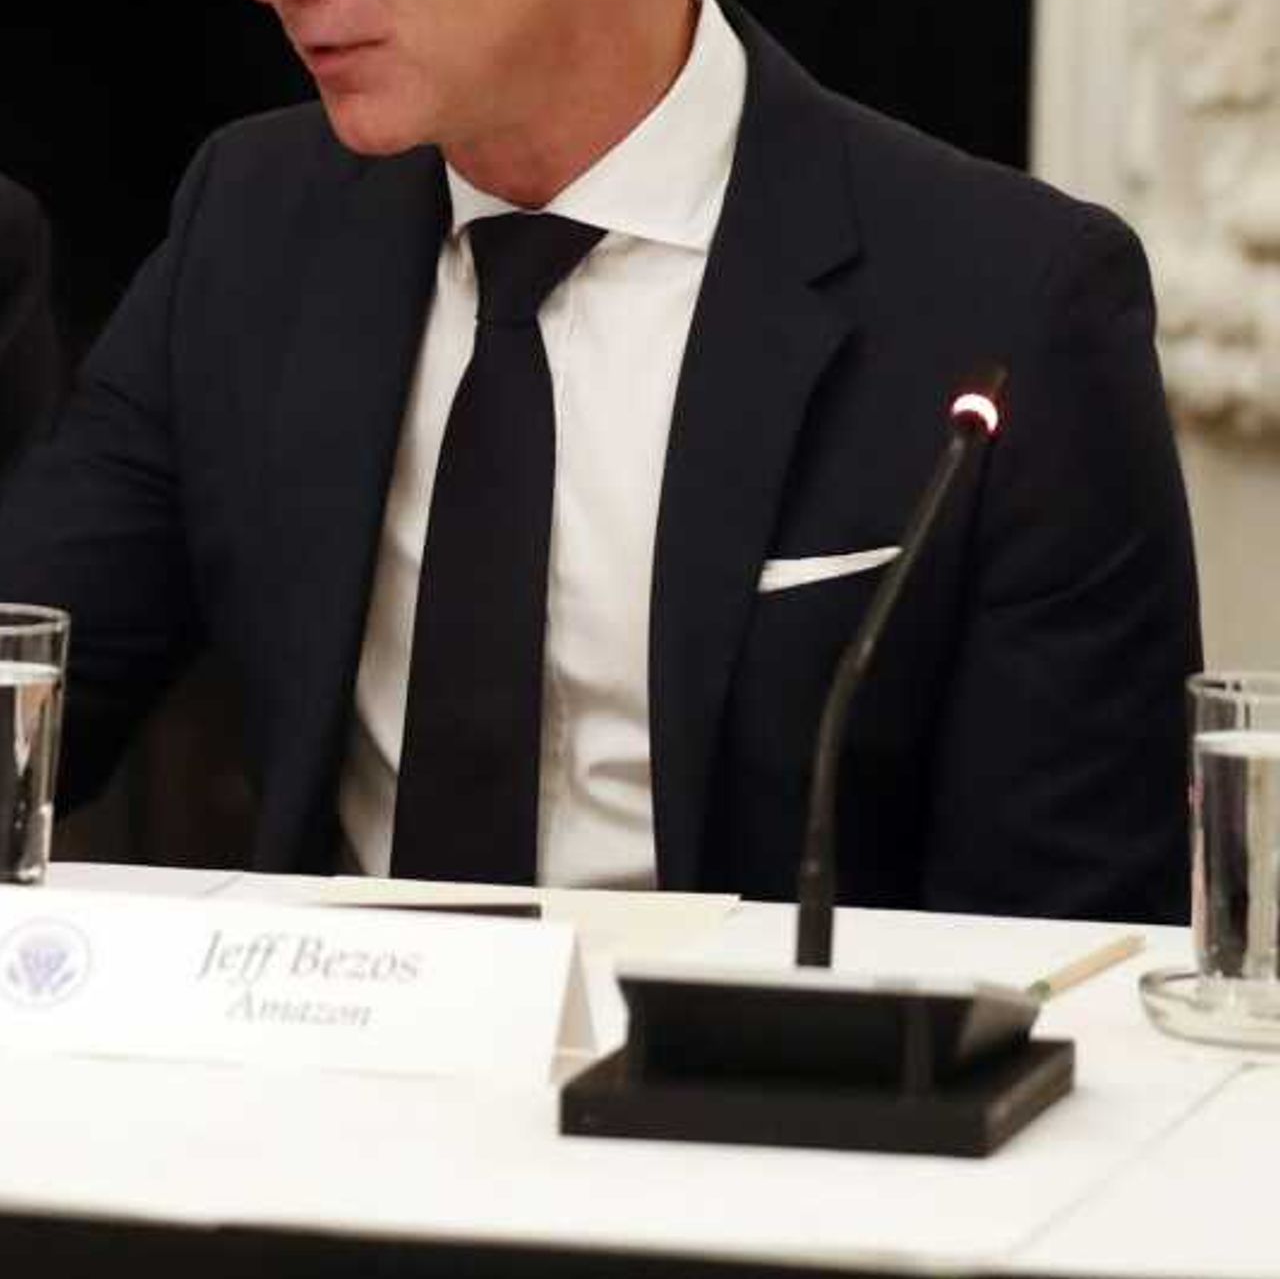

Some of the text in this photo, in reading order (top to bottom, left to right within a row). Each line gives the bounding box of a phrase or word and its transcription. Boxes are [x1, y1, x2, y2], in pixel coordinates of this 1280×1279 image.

[196, 930, 421, 985] Jeff Bezos
[225, 989, 372, 1027] Amazon
